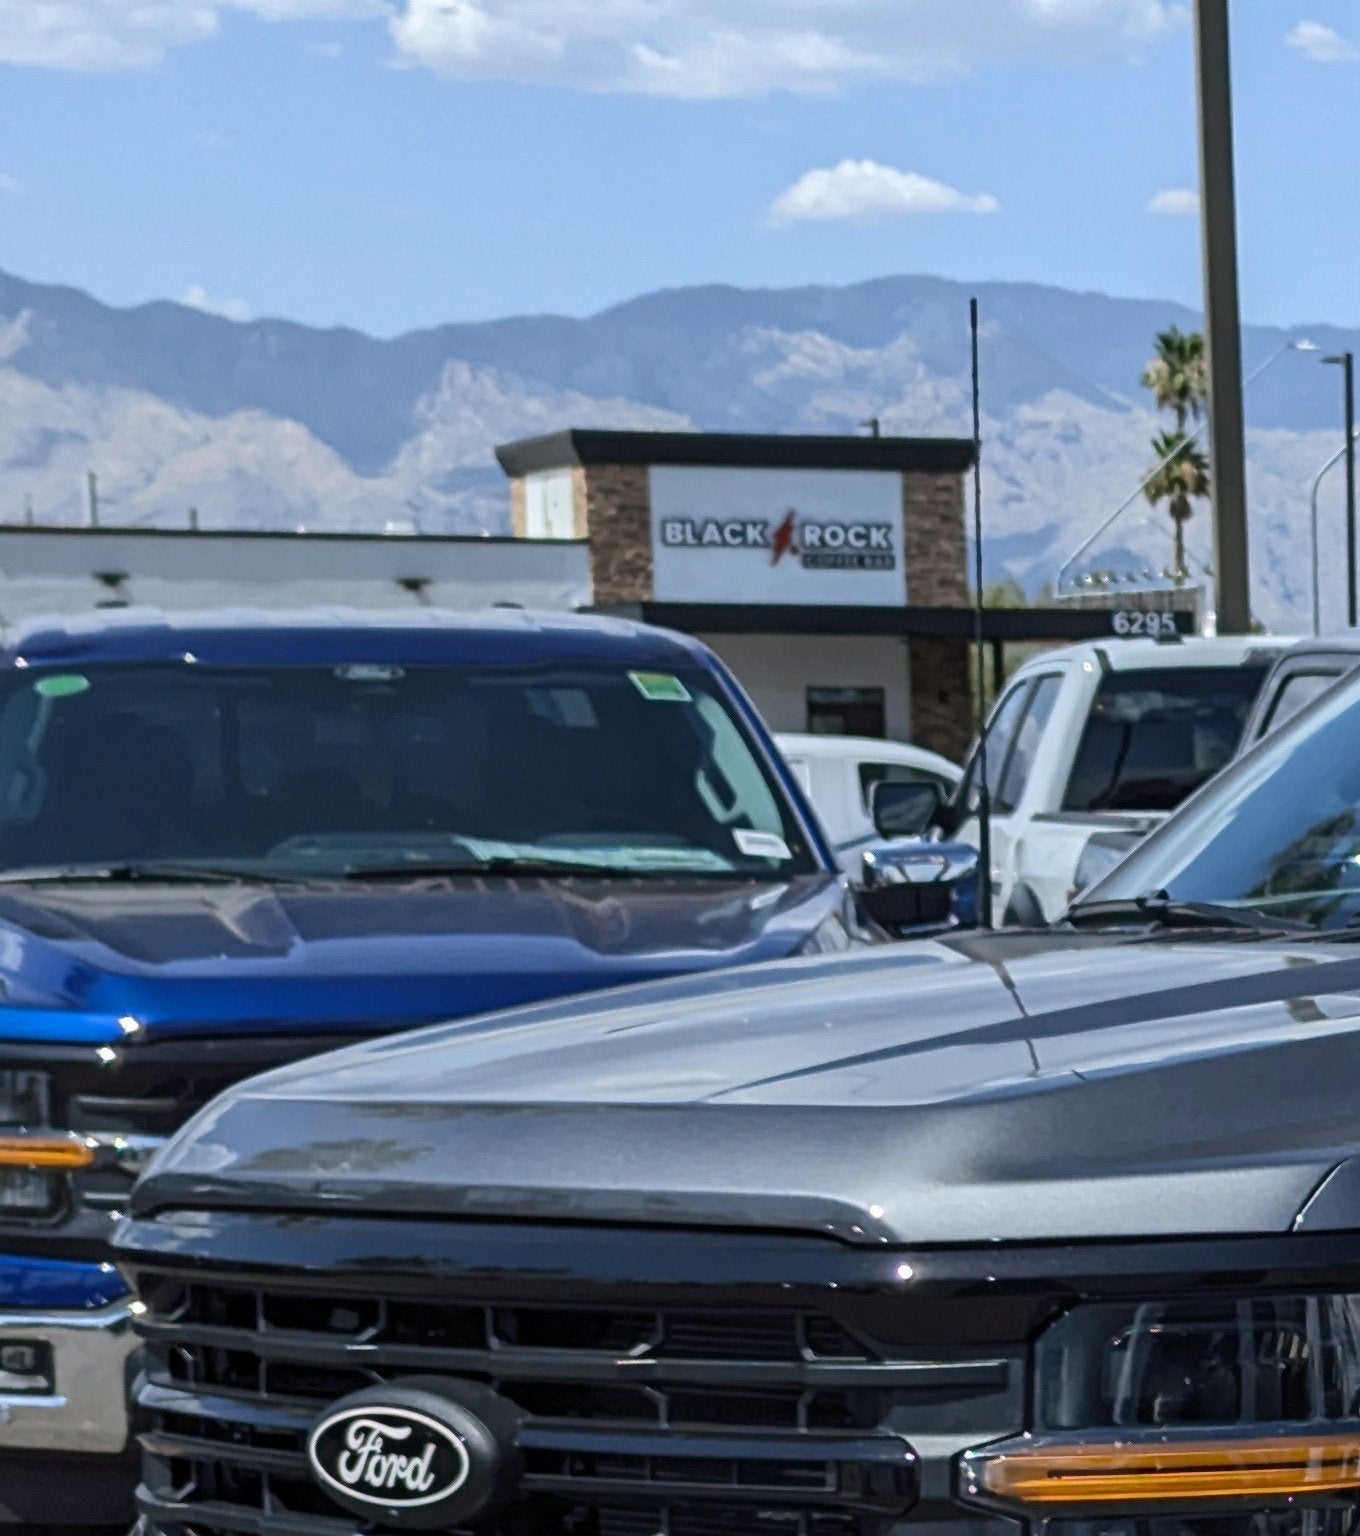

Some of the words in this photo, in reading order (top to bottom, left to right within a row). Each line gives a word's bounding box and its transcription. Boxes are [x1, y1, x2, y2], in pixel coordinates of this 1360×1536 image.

[664, 521, 767, 546] BLACK
[803, 524, 892, 549] ROCK
[1112, 611, 1176, 636] 6295
[338, 1418, 437, 1492] Ford
